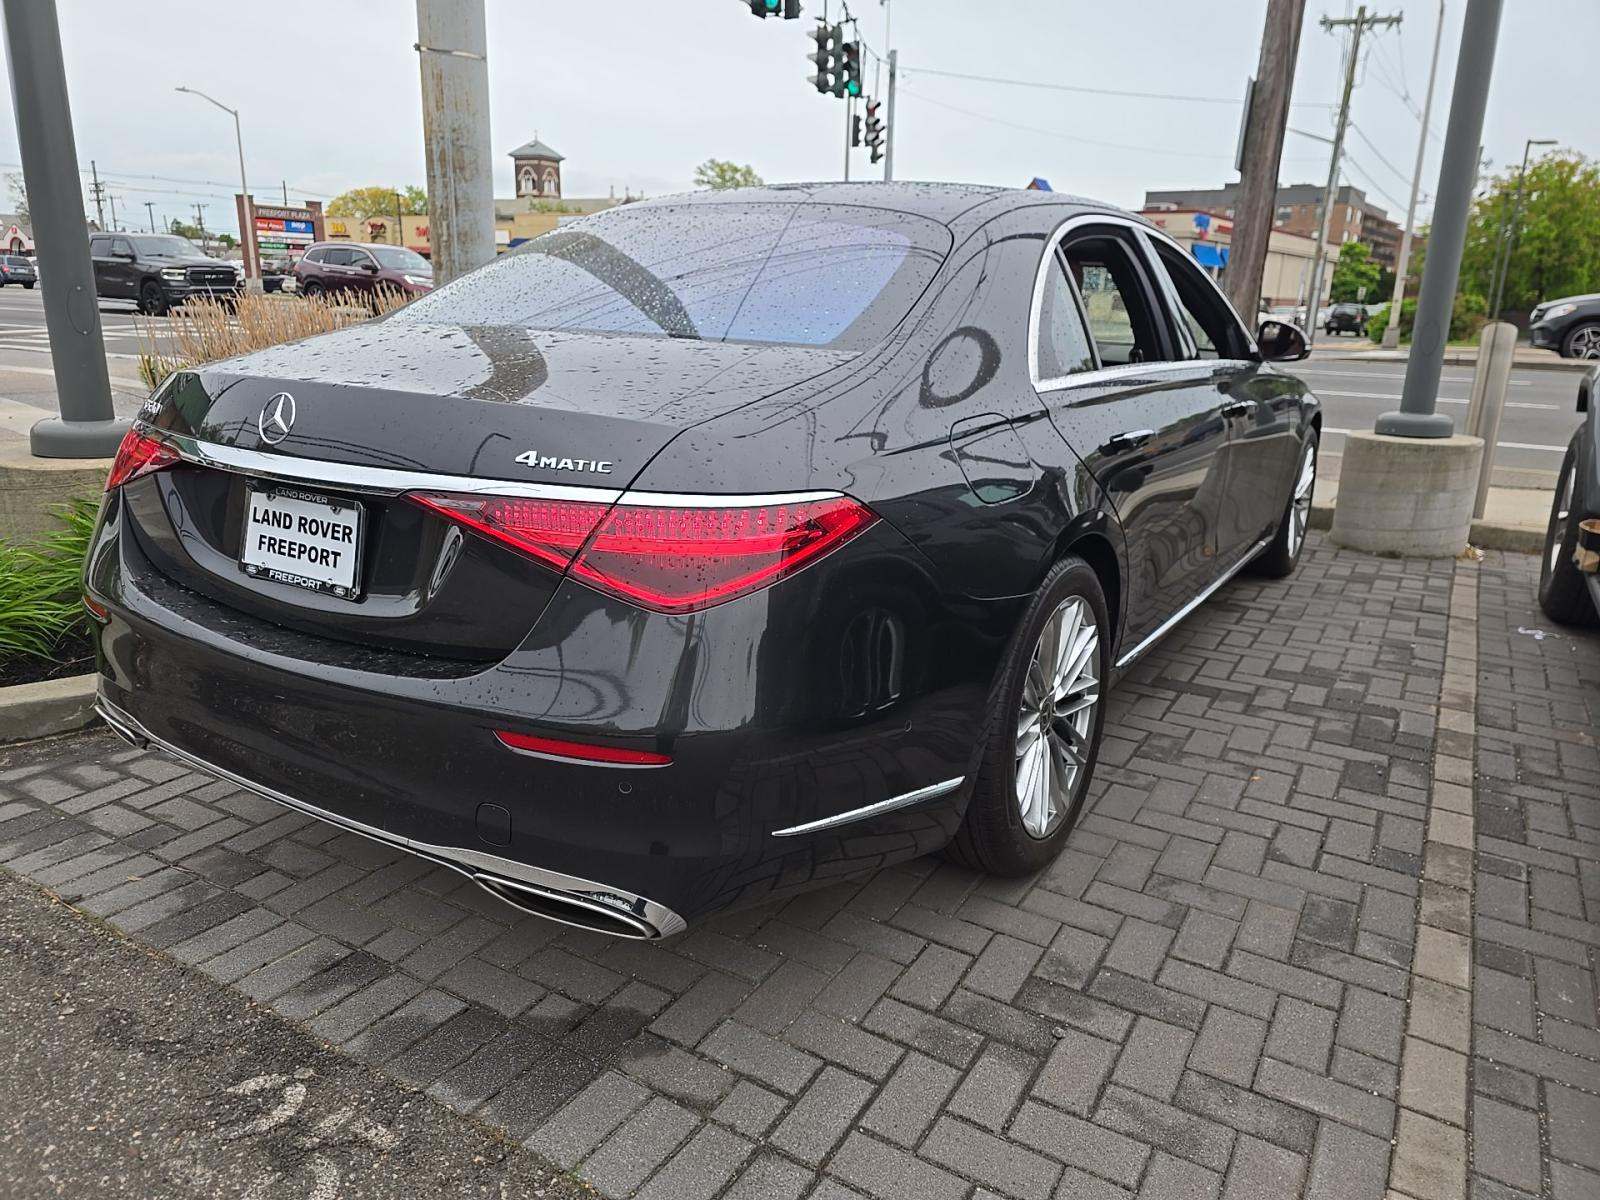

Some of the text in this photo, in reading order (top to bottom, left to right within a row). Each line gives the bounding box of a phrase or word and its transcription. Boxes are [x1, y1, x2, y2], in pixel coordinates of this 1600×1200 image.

[514, 450, 613, 474] 4MATIC
[275, 488, 328, 504] LAND ROVER
[252, 506, 353, 544] LAND ROVER
[257, 534, 342, 569] FREEPORT
[268, 569, 323, 590] FREEPORT
